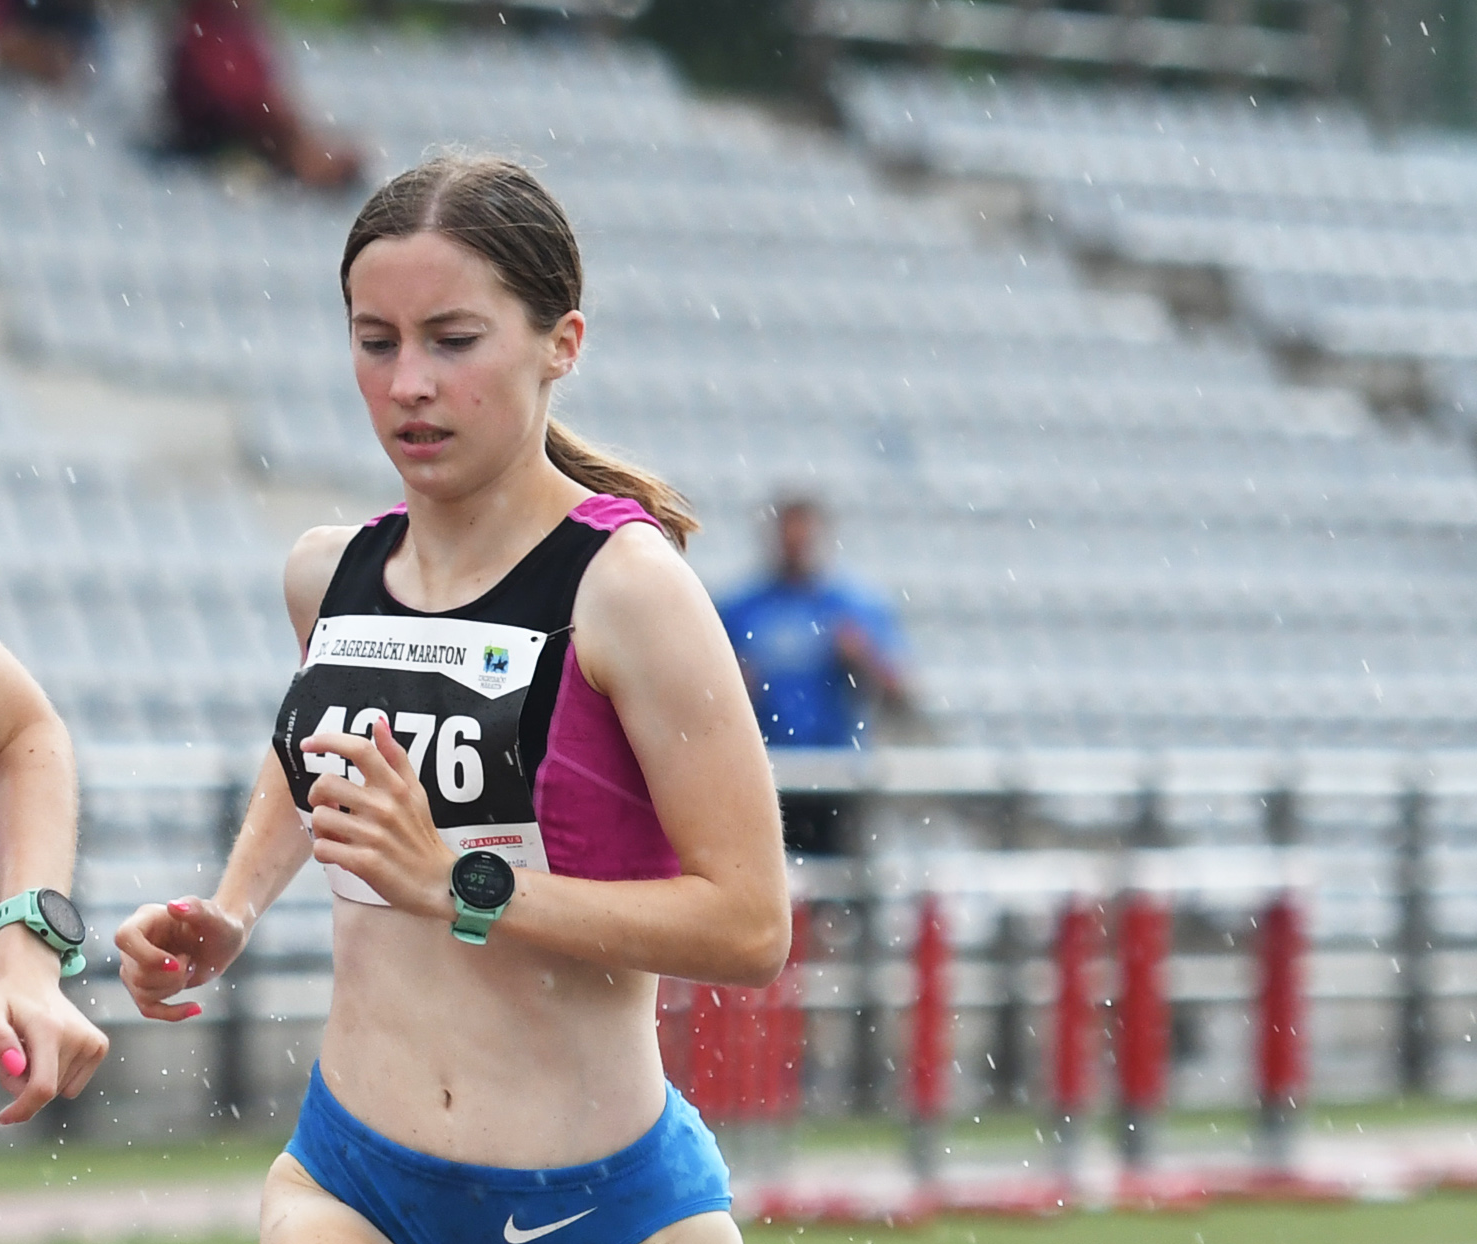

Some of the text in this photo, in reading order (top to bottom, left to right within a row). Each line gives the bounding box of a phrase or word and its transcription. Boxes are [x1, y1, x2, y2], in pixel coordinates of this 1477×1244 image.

[330, 637, 406, 661] ZAGREBAČKI
[406, 643, 467, 666] MARATON
[469, 836, 522, 847] BAUHAUS
